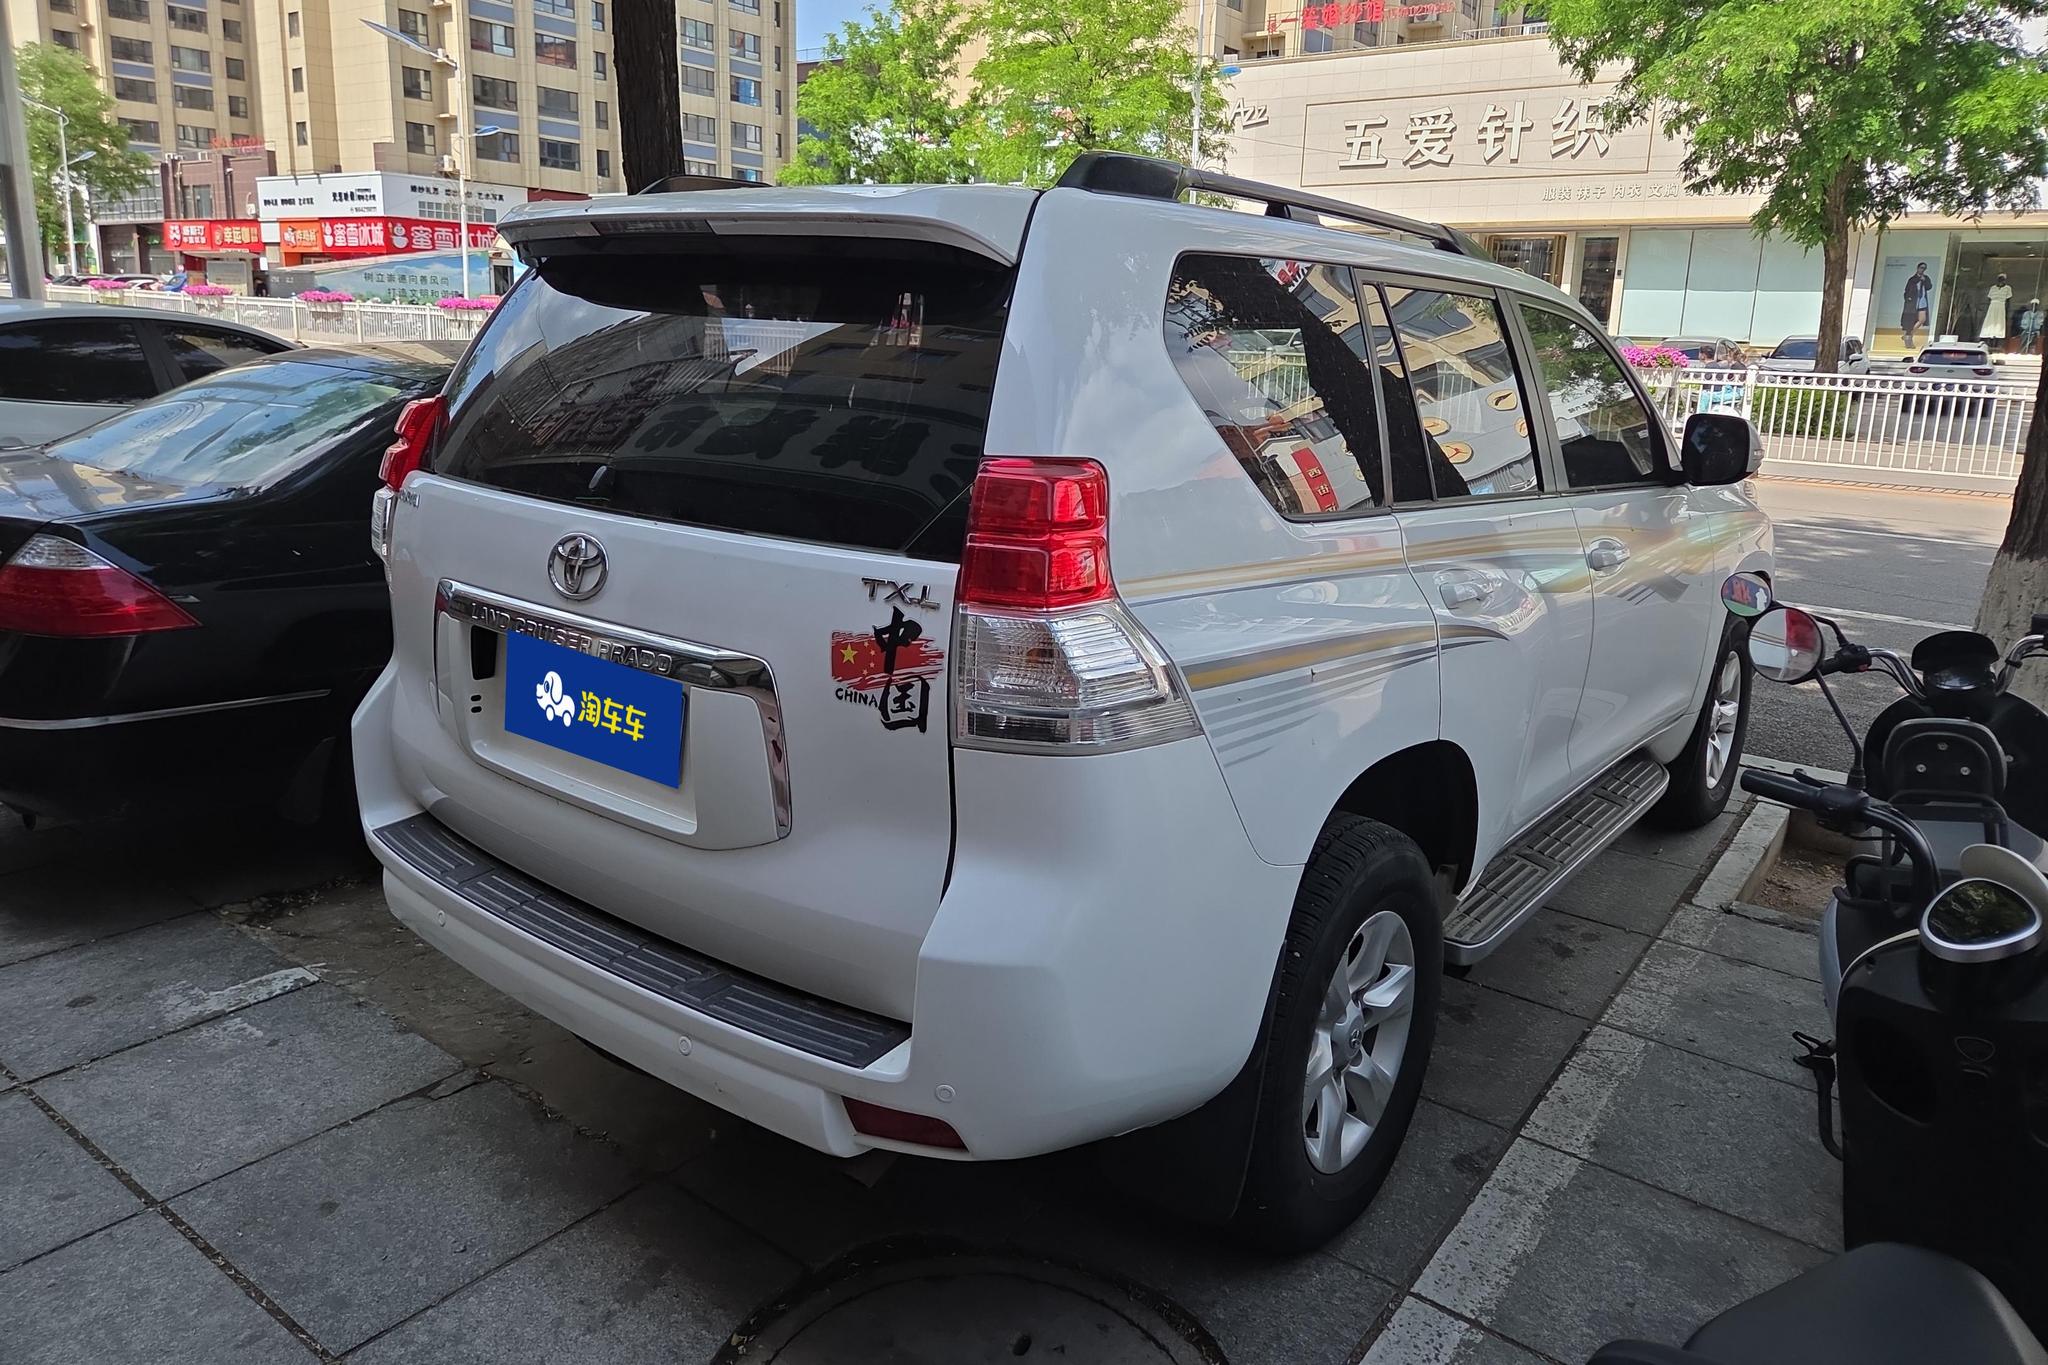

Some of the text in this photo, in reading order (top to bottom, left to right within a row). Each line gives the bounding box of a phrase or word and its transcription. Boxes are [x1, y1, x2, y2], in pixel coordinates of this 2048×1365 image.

[1338, 97, 1610, 170] 五爱针织
[1542, 186, 1572, 201] 服装
[1576, 185, 1608, 201] 袜子
[1612, 184, 1641, 199] 内衣
[1648, 183, 1680, 198] 文胸
[333, 222, 385, 247] 蜜雪冰城
[411, 225, 496, 250] 蜜雪冰城
[364, 271, 449, 287] 树立崇德向善风尚
[471, 602, 673, 675] LAND CRUISER PRADO
[872, 605, 930, 734] 中国
[835, 687, 882, 710] CHINA
